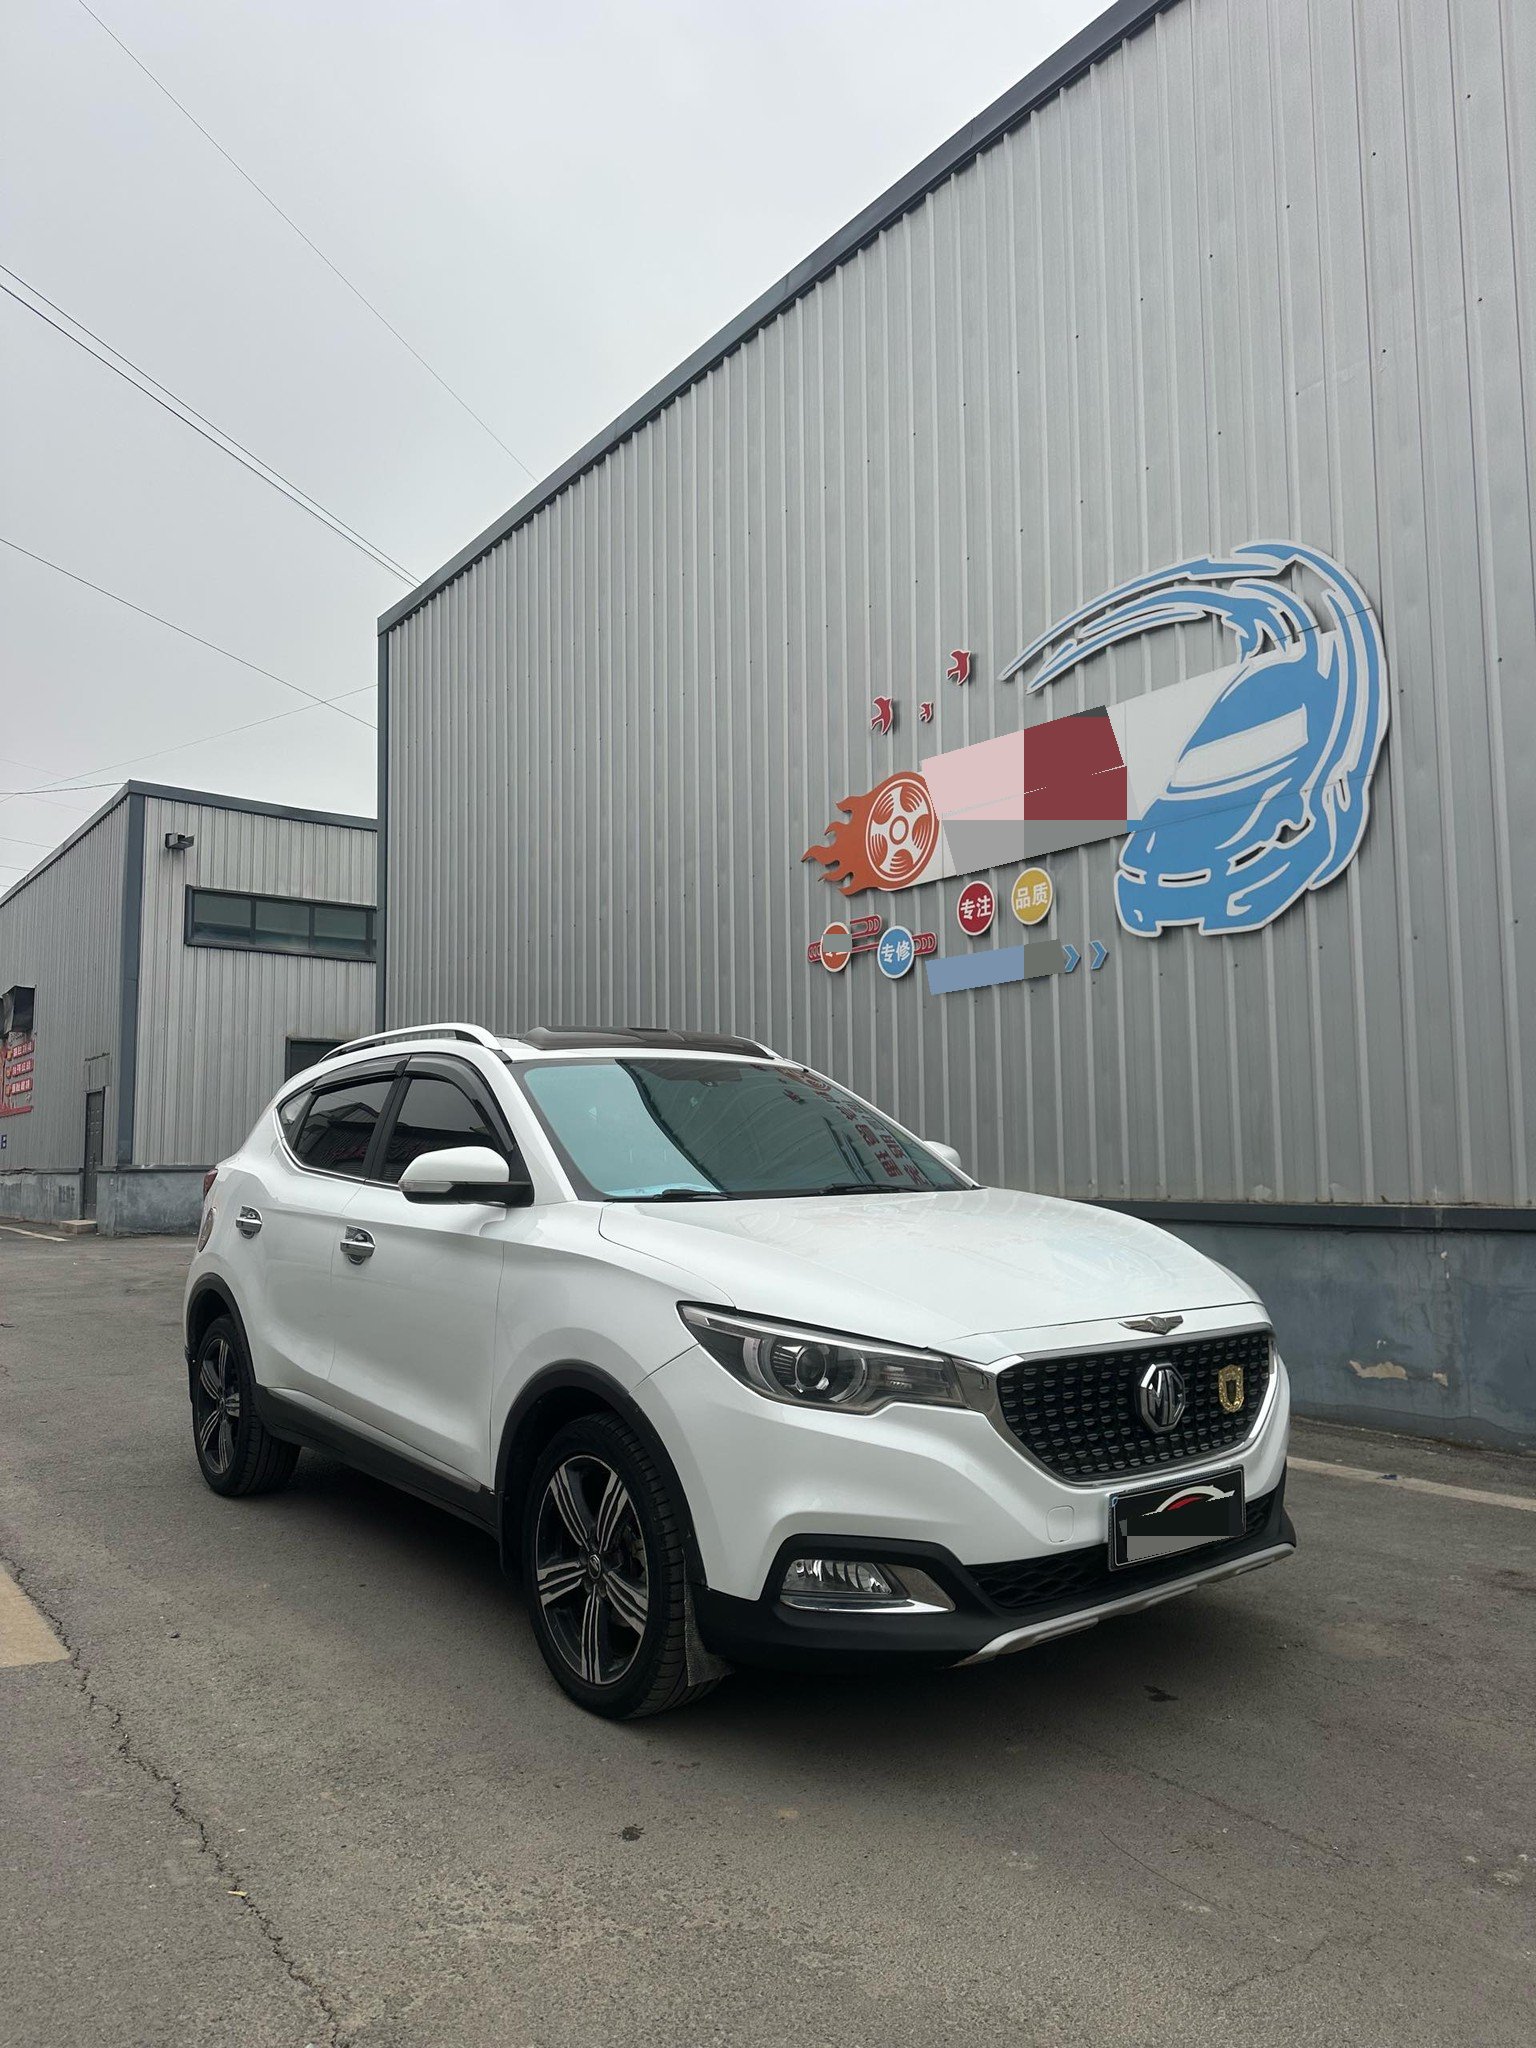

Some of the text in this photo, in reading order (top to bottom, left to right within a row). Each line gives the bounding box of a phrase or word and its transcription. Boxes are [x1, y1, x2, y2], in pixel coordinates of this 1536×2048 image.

[960, 896, 991, 920] 专注
[1015, 884, 1048, 910] 品质
[880, 941, 911, 963] 专修
